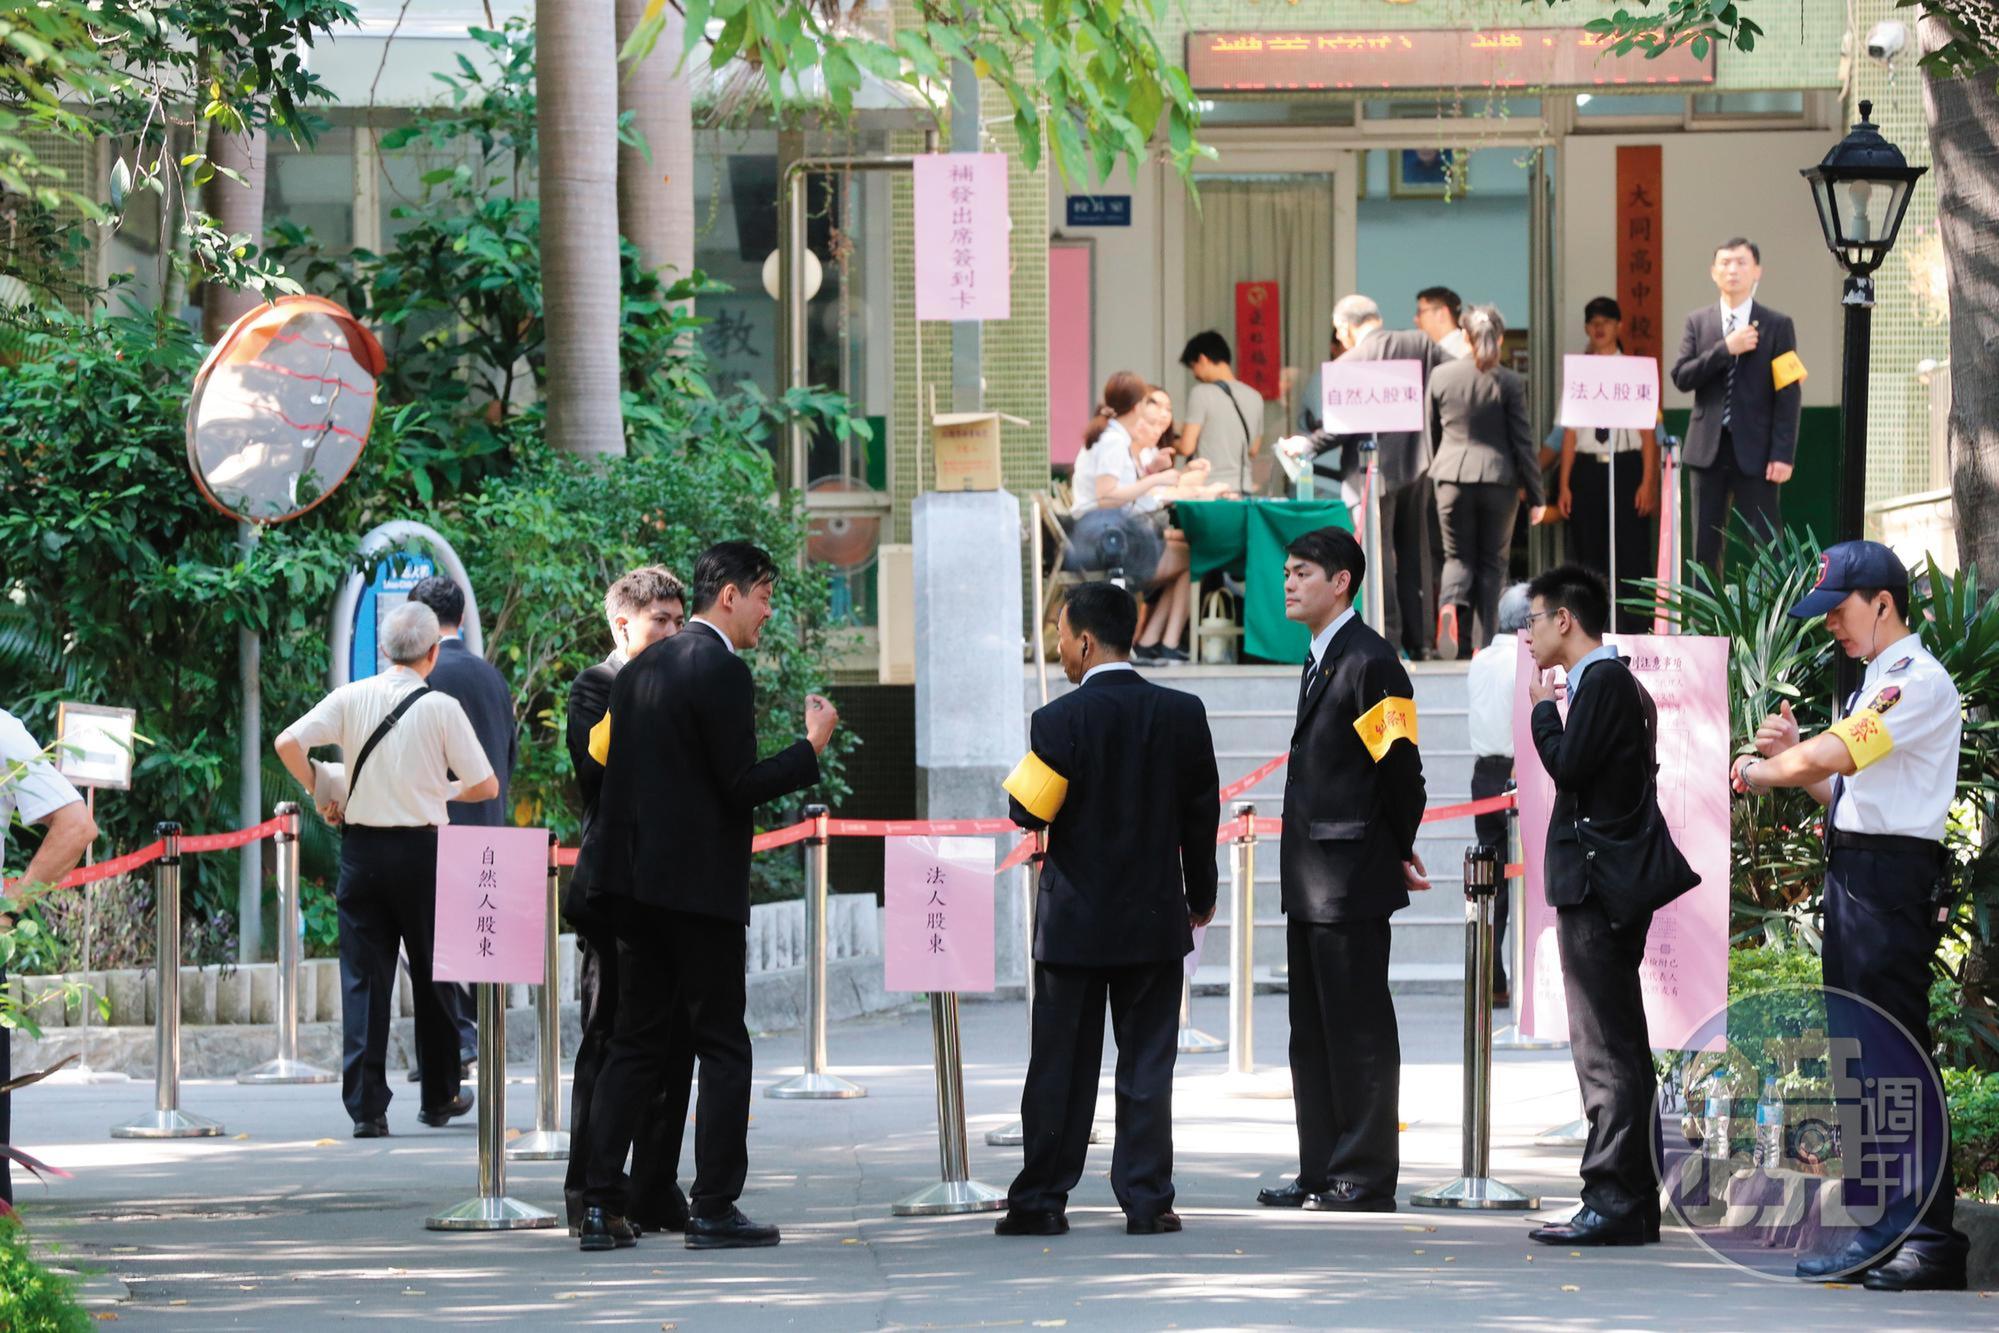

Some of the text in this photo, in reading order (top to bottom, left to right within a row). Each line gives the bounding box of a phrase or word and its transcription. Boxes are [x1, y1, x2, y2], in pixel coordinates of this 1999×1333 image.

[950, 164, 975, 310] 補發出席簽到卡
[1328, 386, 1417, 406] 自然人股東
[1570, 381, 1652, 401] 法人股東
[476, 846, 497, 957] 自然人股東
[926, 866, 947, 954] 法人股東
